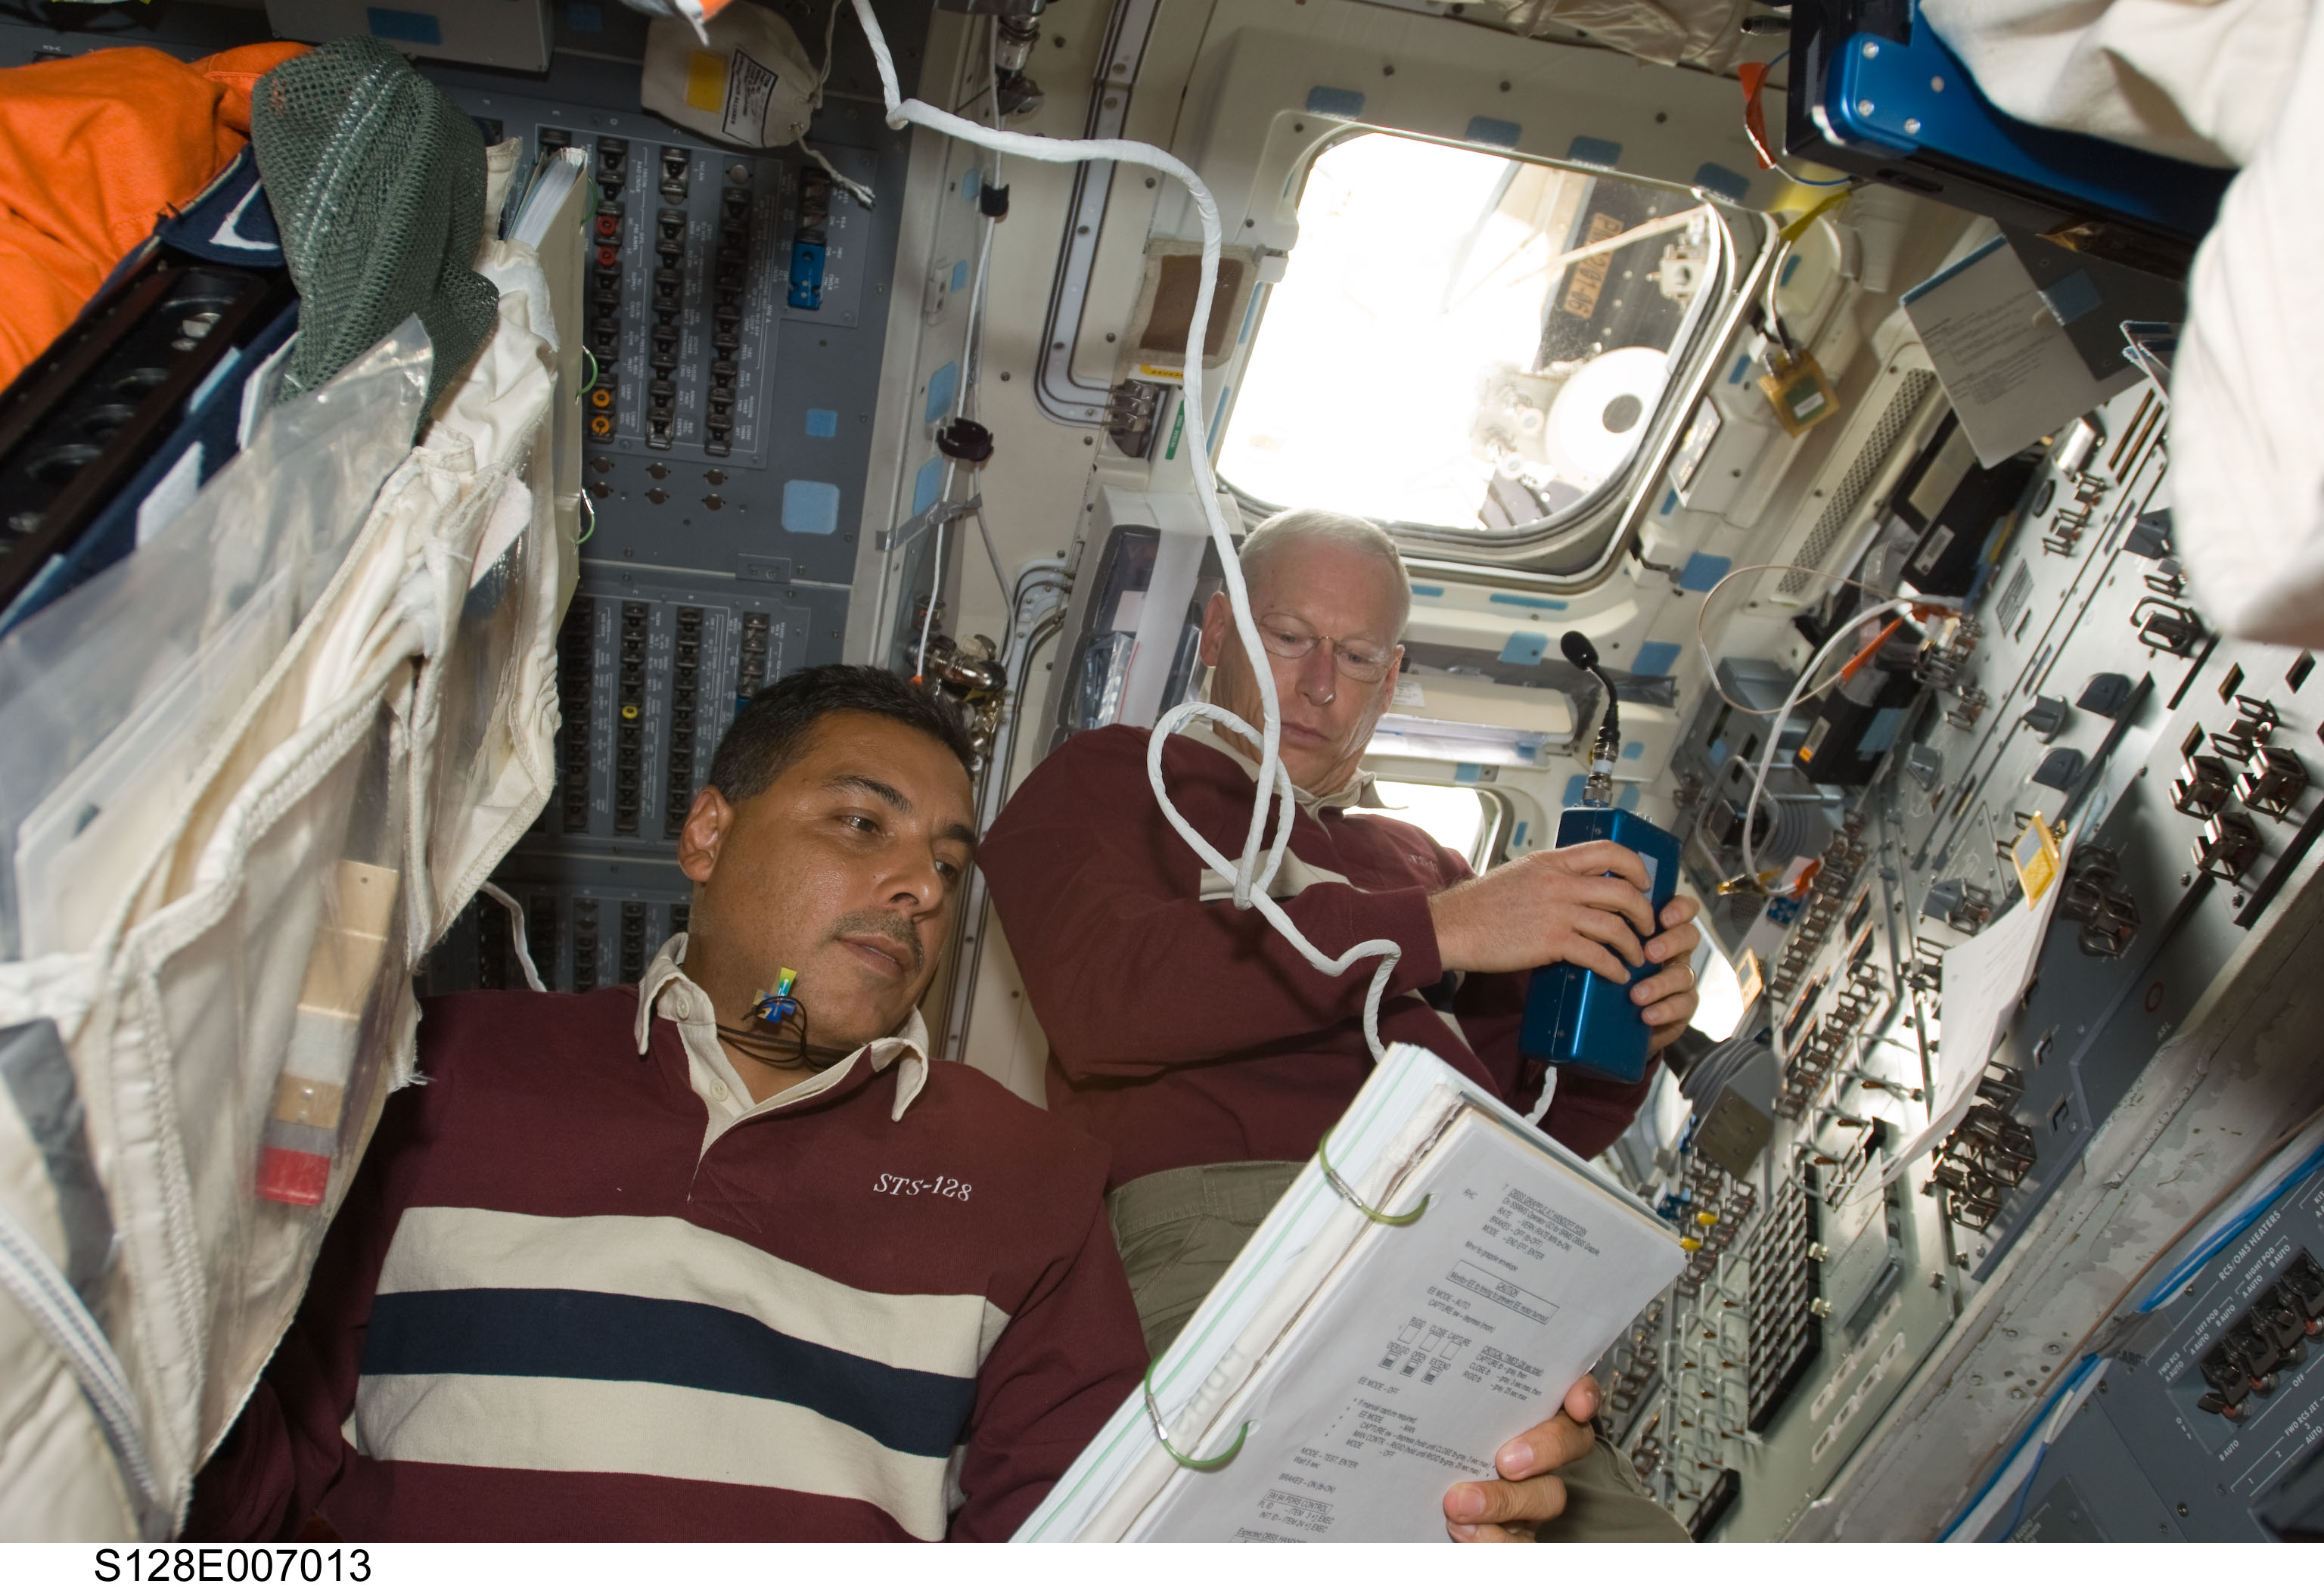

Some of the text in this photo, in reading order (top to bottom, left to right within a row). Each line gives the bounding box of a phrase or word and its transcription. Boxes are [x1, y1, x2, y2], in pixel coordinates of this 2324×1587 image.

[873, 1173, 972, 1202] STS-128
[1496, 1207, 1512, 1219] RATE
[1523, 1196, 1549, 1214] GRAPPLE
[1489, 1215, 1512, 1231] BRAKES
[1482, 1224, 1499, 1237] MODE
[1527, 1247, 1545, 1261] ENTER
[2217, 1209, 2282, 1281] RCS/OMS HEATERS
[2273, 1243, 2291, 1263] AUTO
[2244, 1245, 2276, 1281] RIGHT POD
[1496, 1281, 1520, 1297] CAUTION
[2245, 1274, 2263, 1294] AUTO
[1427, 1298, 1454, 1315] CAPTURE
[1435, 1289, 1452, 1302] MODE
[1454, 1297, 1471, 1310] AUTO
[2218, 1303, 2236, 1321] AUTO
[2194, 1308, 2220, 1335] LEFT POD
[1429, 1324, 1448, 1337] CLOSE
[1446, 1331, 1472, 1348] CAPTURE
[2192, 1332, 2211, 1350] AUTO
[1411, 1349, 1428, 1362] OPEN
[1429, 1356, 1452, 1371] EXTEND
[1475, 1354, 1499, 1368] CAPTURE
[2158, 1351, 2180, 1375] FWD RCS
[2167, 1360, 2185, 1377] AUTO
[1366, 1379, 1384, 1390] MODE
[1387, 1386, 1400, 1396] OFF
[2292, 1374, 2305, 1387] OFF
[1366, 1412, 1384, 1424] MODE
[2283, 1400, 2320, 1436] FWD RCS JET
[1359, 1421, 1387, 1435] CAPTURE
[2304, 1424, 2324, 1444] AUTO
[1346, 1438, 1364, 1449] MODE
[1353, 1430, 1367, 1439] MAN
[1365, 1433, 1385, 1446] CONTR
[2222, 1439, 2240, 1457] AUTO
[1300, 1447, 1319, 1458] MODE
[1338, 1458, 1359, 1469] ENTER
[1278, 1472, 1304, 1485] BRAKES
[1284, 1495, 1302, 1505] PDRS
[1300, 1500, 1328, 1512] CONTROL
[1259, 1511, 1272, 1520] INIT
[1282, 1516, 1297, 1526] ITEM
[1310, 1523, 1328, 1533] EXEC
[1288, 1508, 1305, 1517] ITEM
[1316, 1514, 1334, 1525] EXEC
